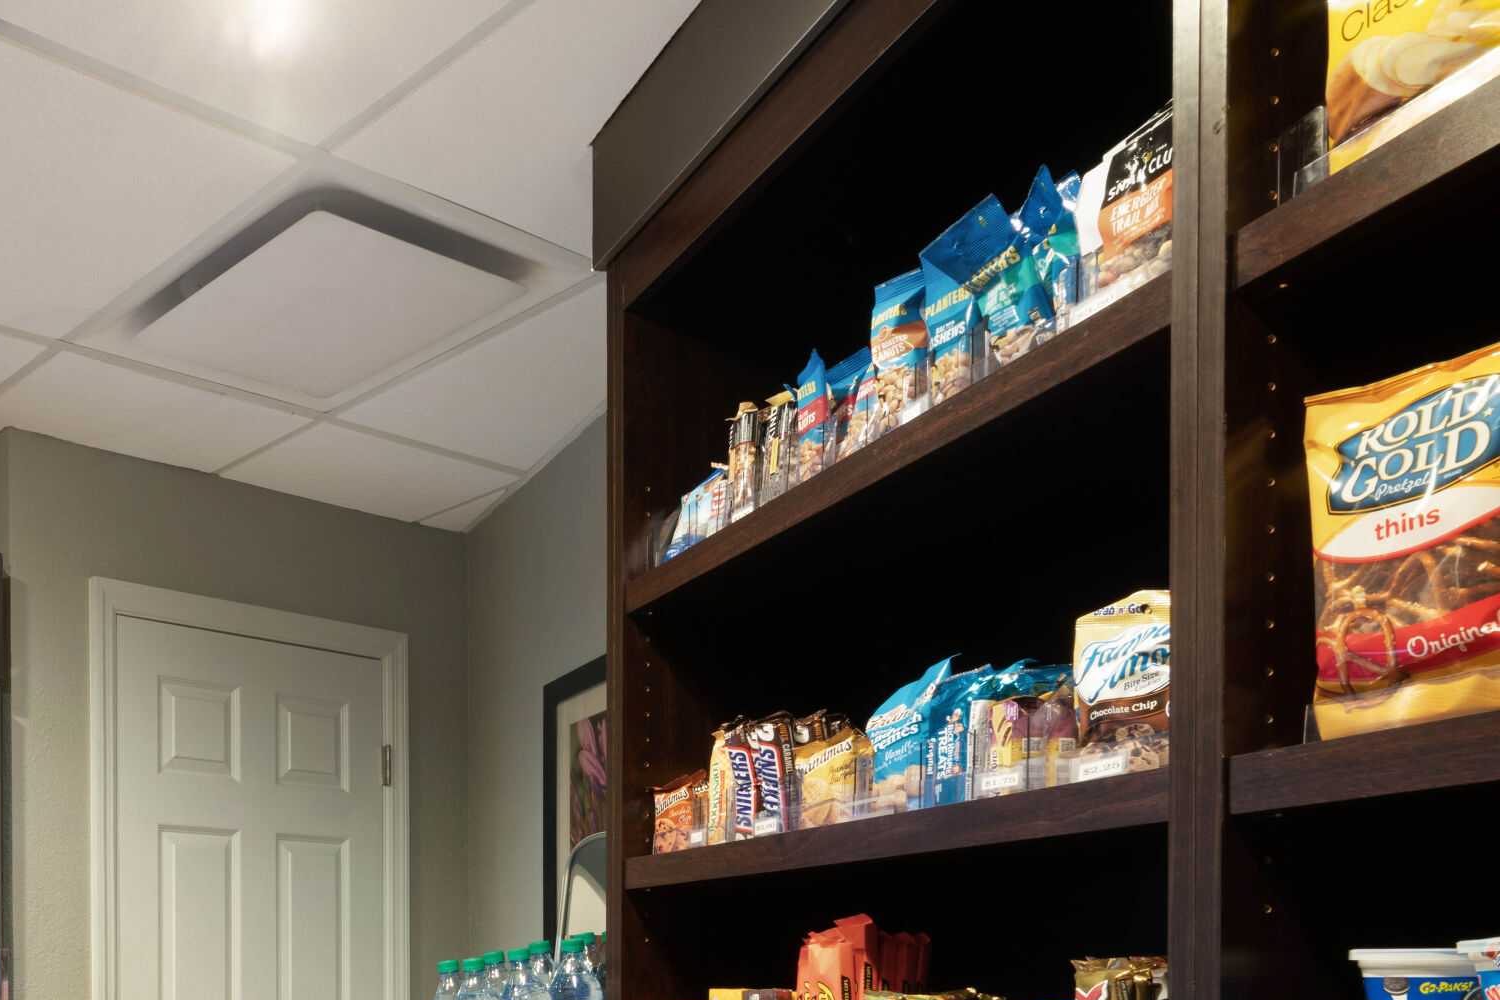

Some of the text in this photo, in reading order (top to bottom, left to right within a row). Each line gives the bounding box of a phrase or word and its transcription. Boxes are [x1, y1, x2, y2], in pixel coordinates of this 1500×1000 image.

[1341, 0, 1408, 42] Cla
[1111, 209, 1141, 237] TRAIL
[925, 288, 970, 319] PLANTERS
[1355, 386, 1490, 460] ROLD
[1341, 419, 1491, 503] GOLD
[1374, 508, 1441, 540] thins
[1123, 670, 1160, 691] Bite Size
[1090, 700, 1158, 720] Chocolate Chip
